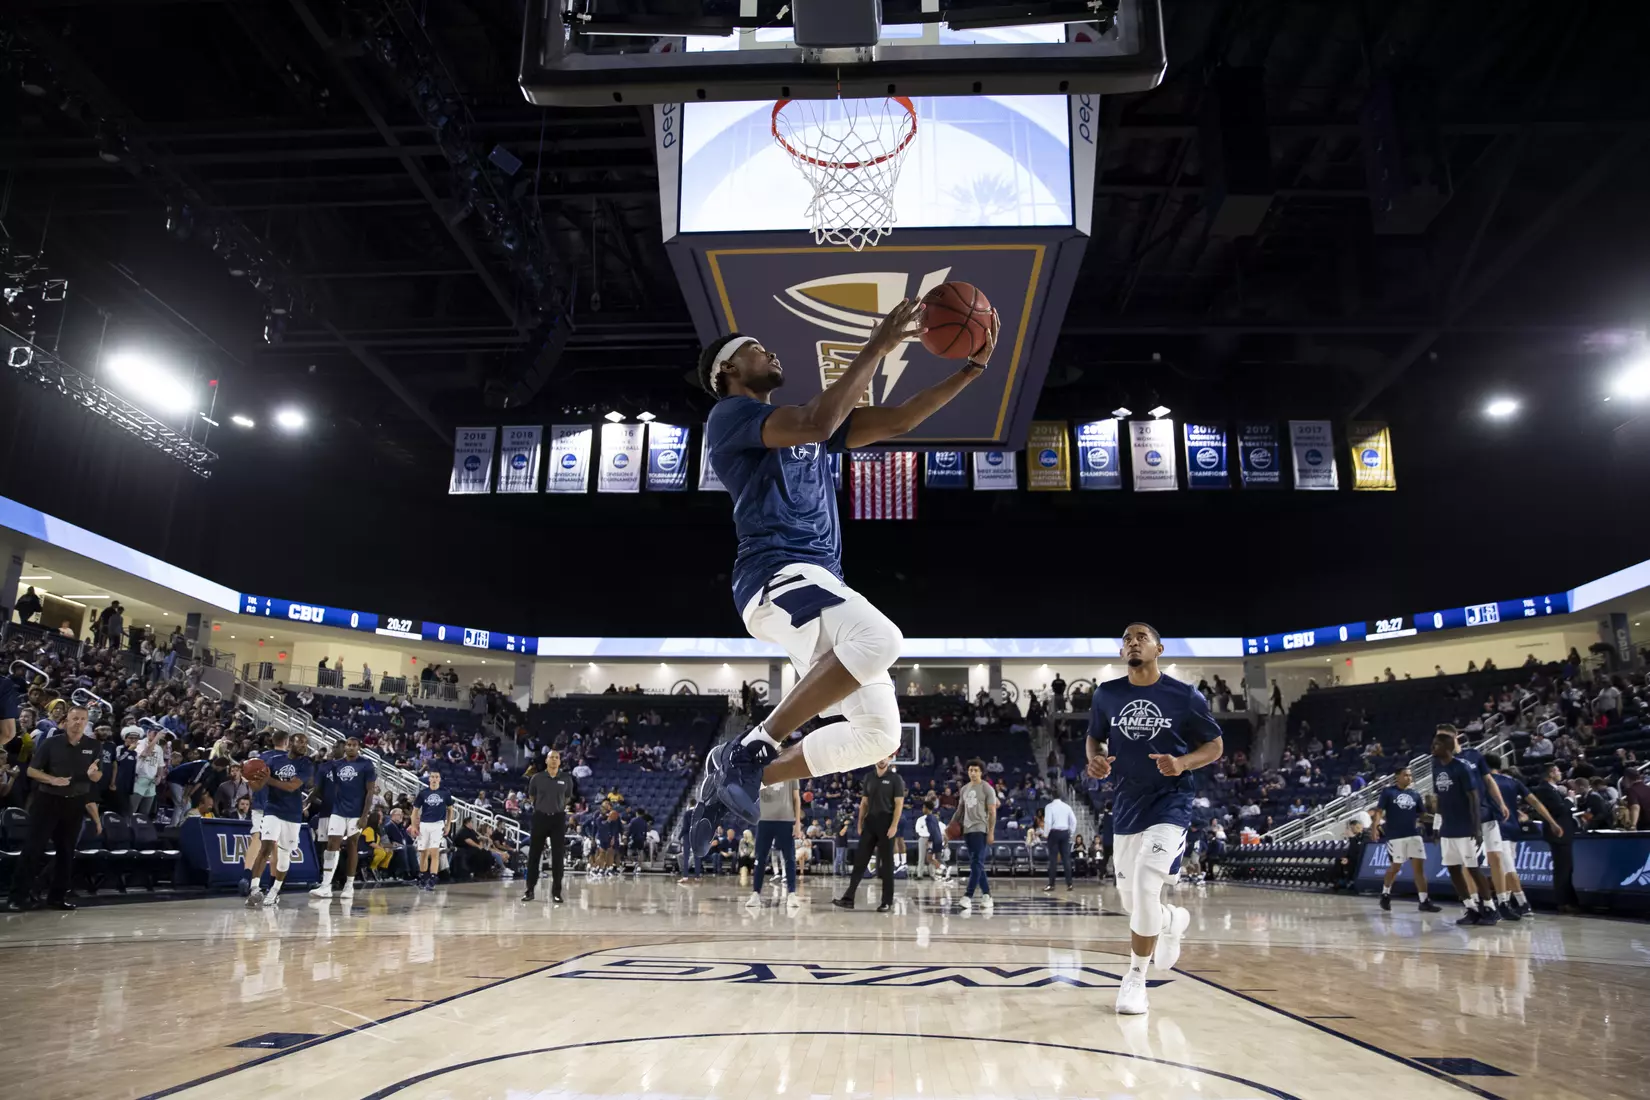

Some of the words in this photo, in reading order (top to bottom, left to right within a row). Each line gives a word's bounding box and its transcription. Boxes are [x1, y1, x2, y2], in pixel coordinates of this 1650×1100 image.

[1079, 94, 1094, 144] pep
[662, 103, 676, 148] pep
[510, 431, 534, 439] 2018
[1192, 424, 1216, 434] 2017
[1246, 426, 1270, 434] 2017
[248, 596, 258, 604] TOL
[246, 605, 256, 613] FLS
[288, 604, 325, 623] CBU
[350, 612, 358, 628] 0
[386, 618, 412, 632] 20:27
[438, 626, 446, 640] 0
[1282, 631, 1314, 650] CBU
[1339, 626, 1348, 642] 0
[1376, 617, 1402, 633] 20:27
[1434, 612, 1443, 628] 0
[1110, 716, 1172, 728] LANCERS
[1516, 841, 1554, 870] ltur
